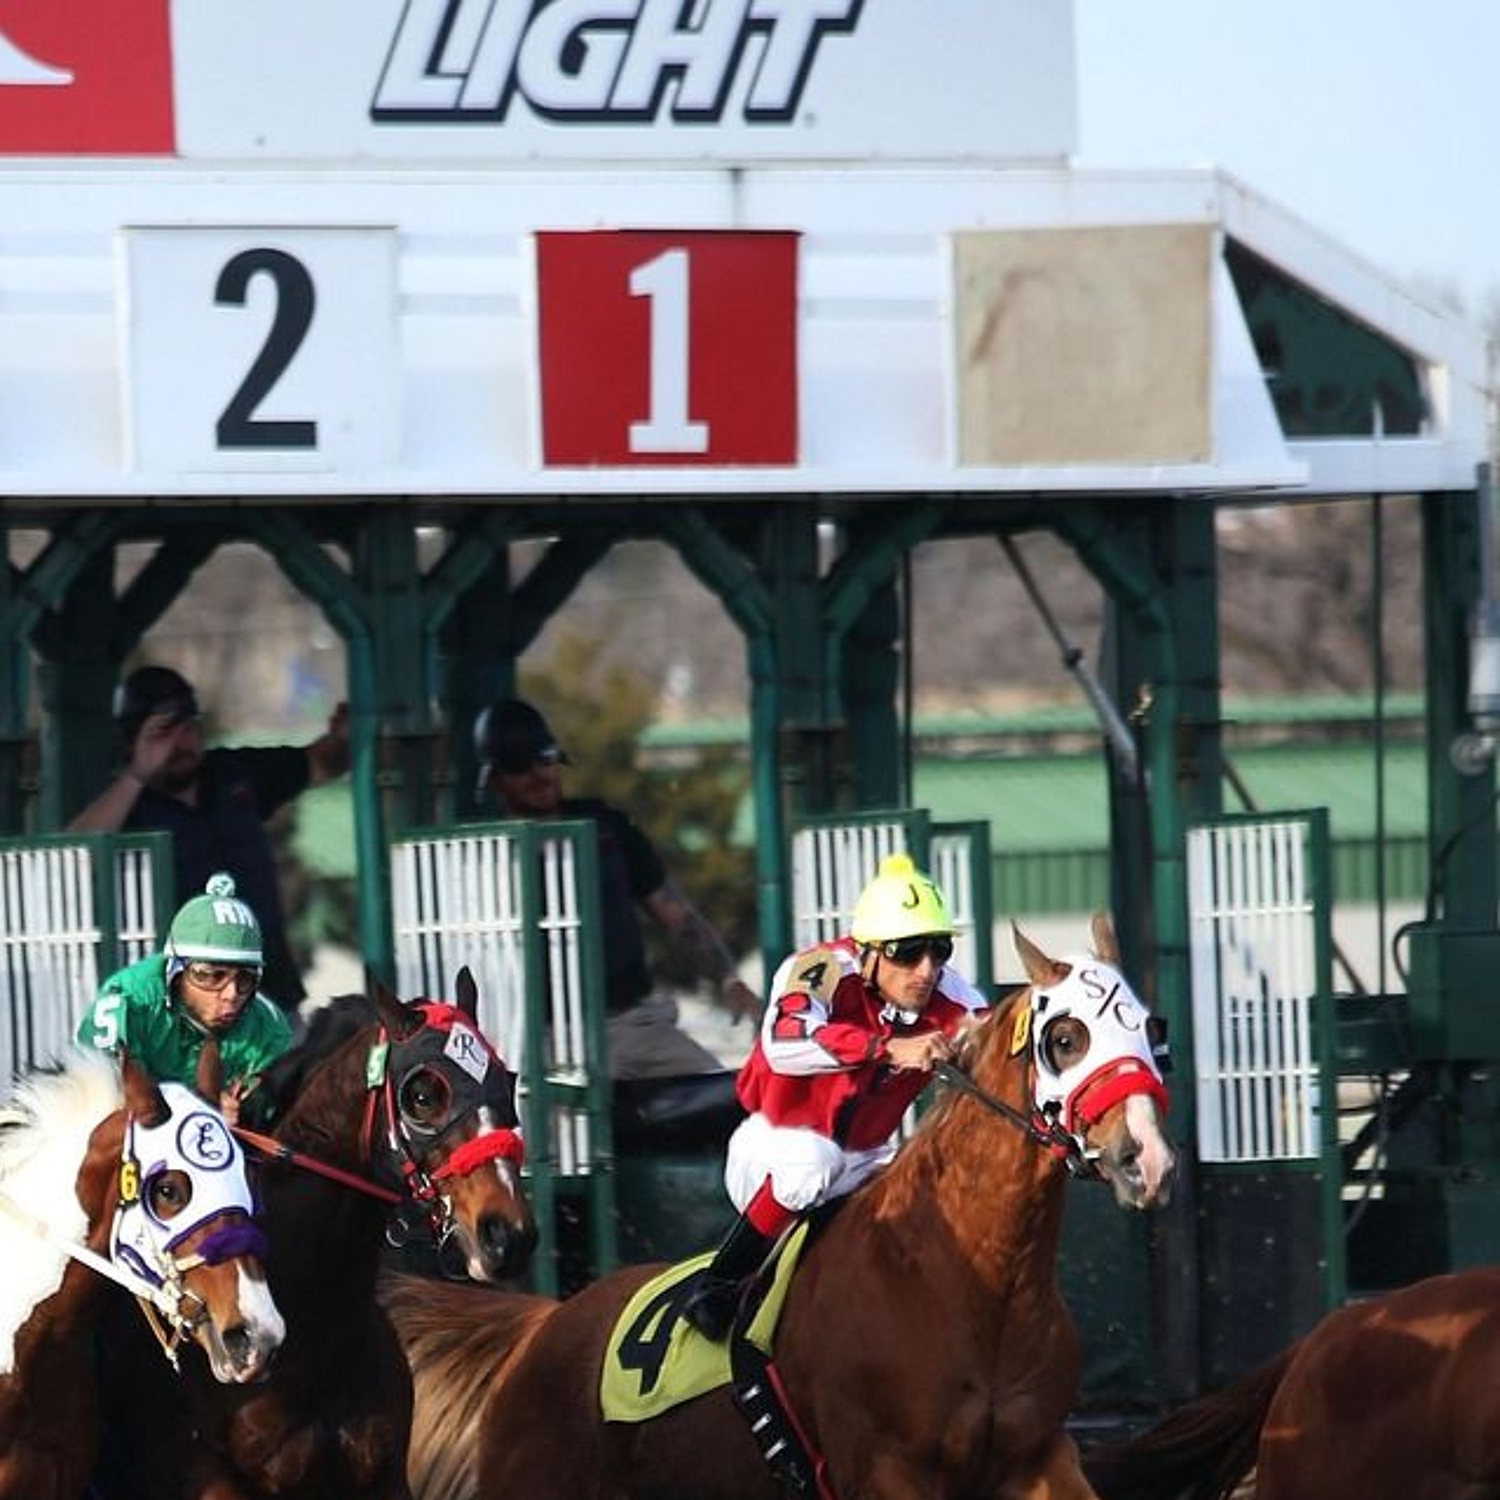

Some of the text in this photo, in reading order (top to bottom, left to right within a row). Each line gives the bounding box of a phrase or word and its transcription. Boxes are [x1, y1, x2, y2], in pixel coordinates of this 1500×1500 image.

[213, 247, 318, 449] 2
[628, 247, 709, 453] 1
[798, 962, 828, 990] 4
[1079, 968, 1141, 1032] S/C
[93, 994, 121, 1050] 5
[453, 1033, 487, 1067] R
[121, 1161, 138, 1201] 6
[617, 1266, 708, 1397] 4
